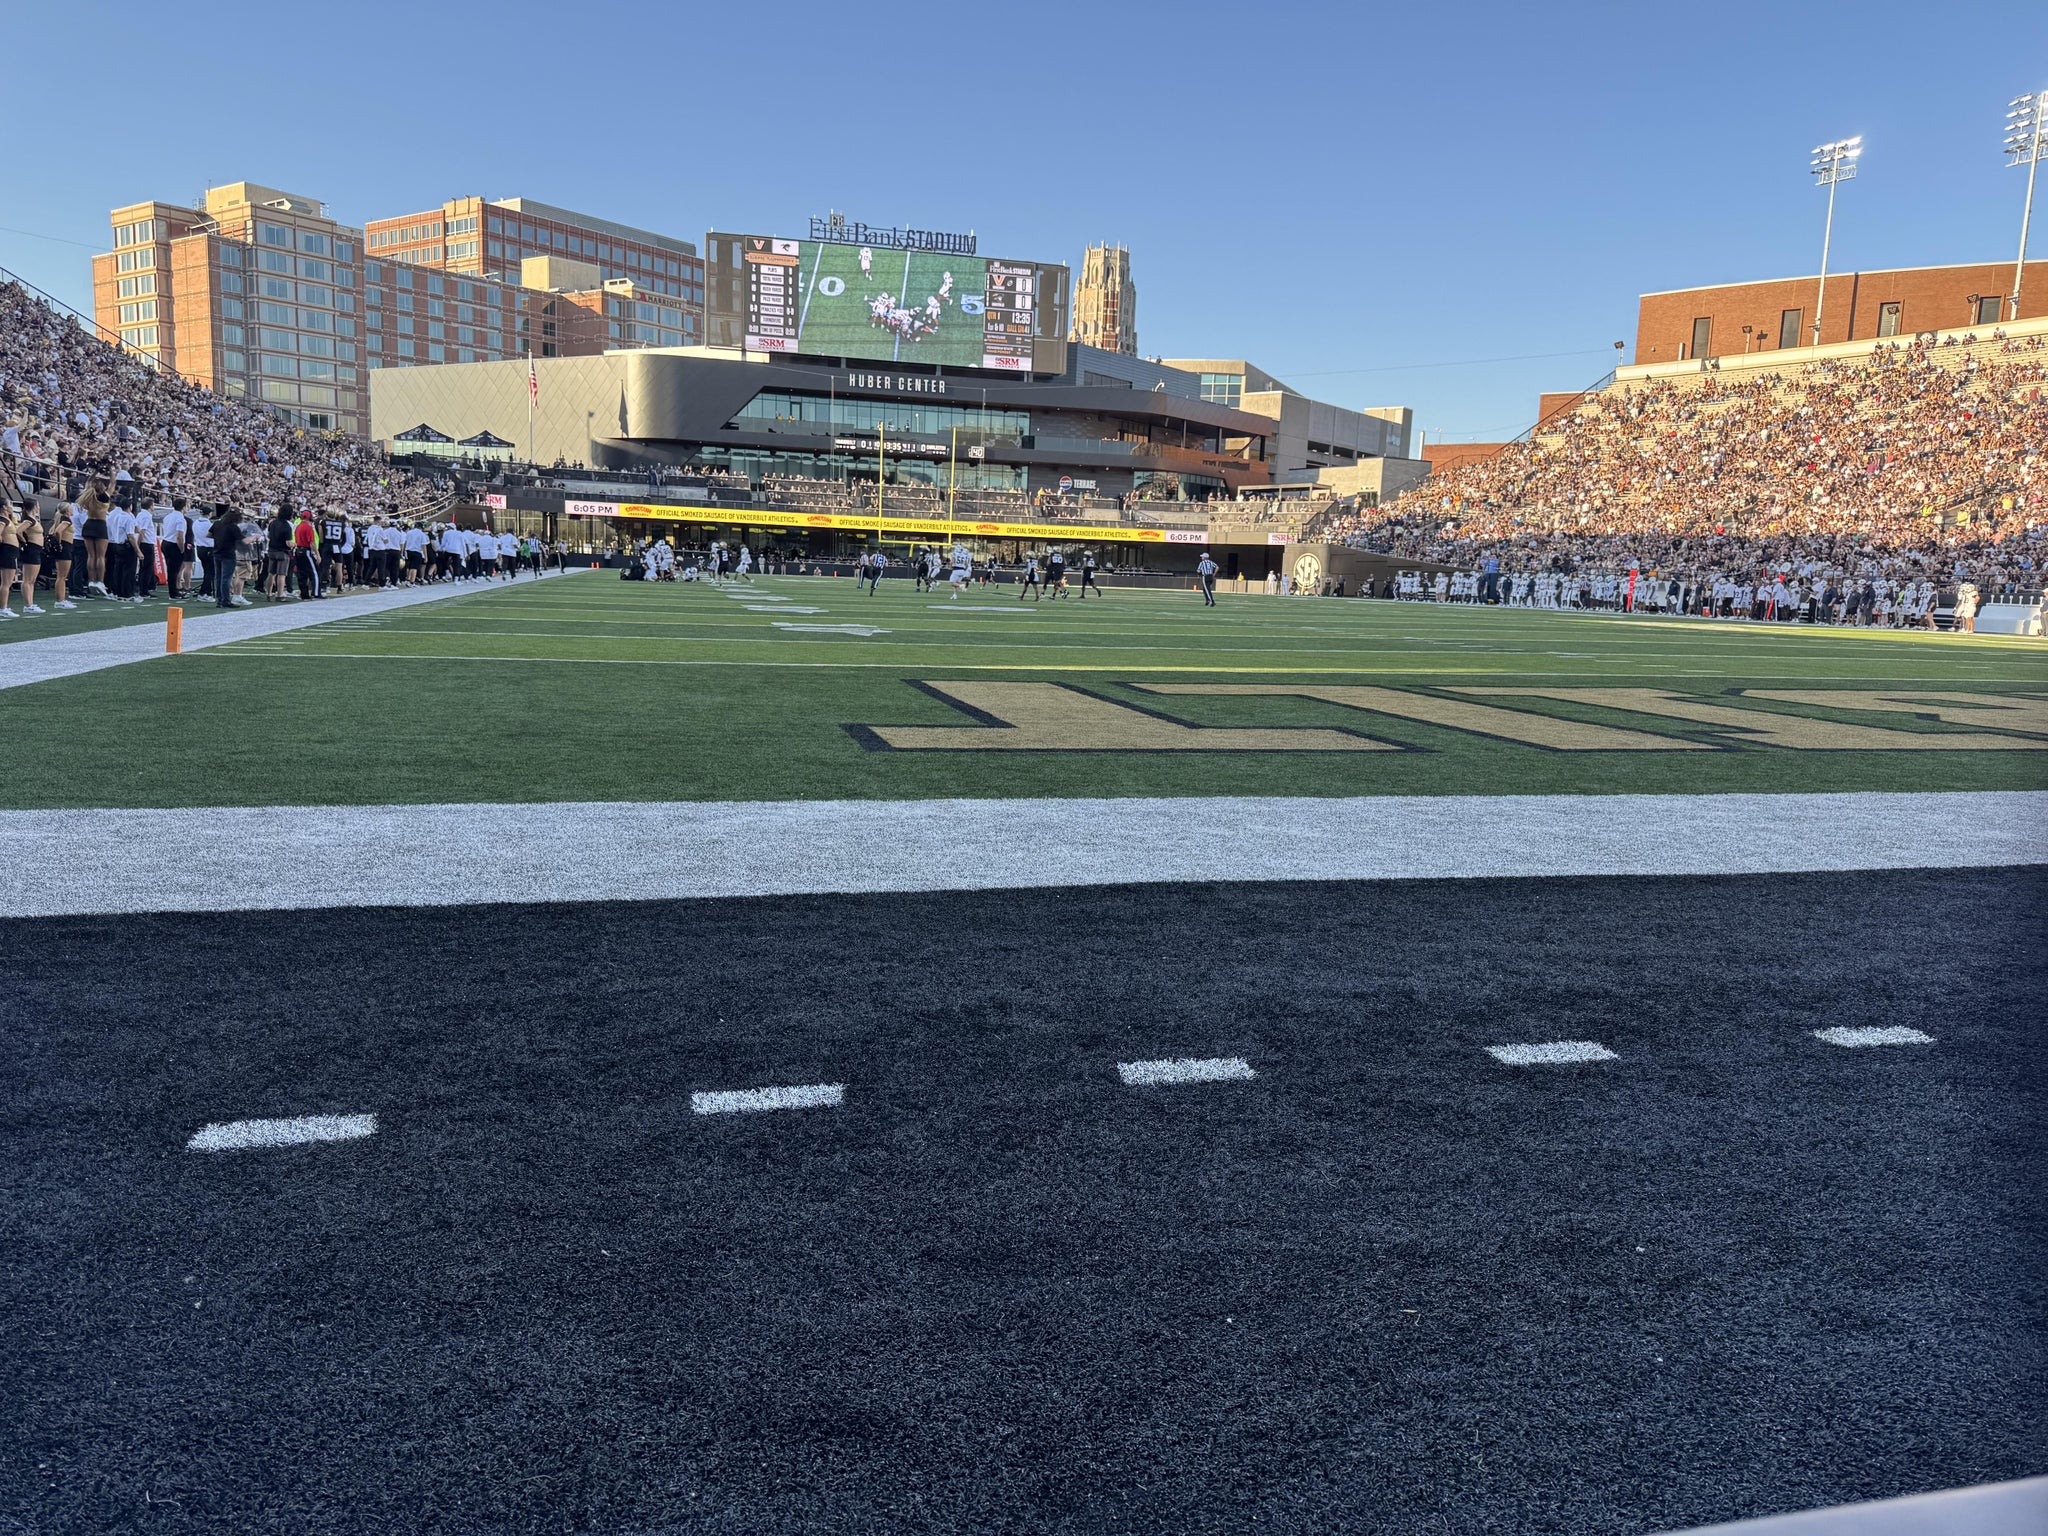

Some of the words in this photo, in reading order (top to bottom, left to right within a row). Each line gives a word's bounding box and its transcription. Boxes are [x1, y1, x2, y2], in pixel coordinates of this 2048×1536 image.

[906, 229, 977, 255] STADIUM
[648, 295, 682, 308] MARRIOTT
[849, 373, 891, 389] HUBER
[898, 378, 945, 394] CENTER
[1073, 479, 1097, 489] TERRACE
[573, 504, 596, 513] 6:05
[598, 505, 613, 514] PM
[656, 509, 679, 517] OFFICIAL
[680, 510, 702, 518] SMOKED
[704, 512, 727, 520] SAUSAGE
[736, 513, 767, 521] VANDERBILT
[839, 519, 861, 527] OFFICIAL
[913, 523, 942, 531] VANDERBILT
[325, 526, 342, 540] 19
[1170, 533, 1188, 541] 6:05
[1189, 534, 1202, 542] PM
